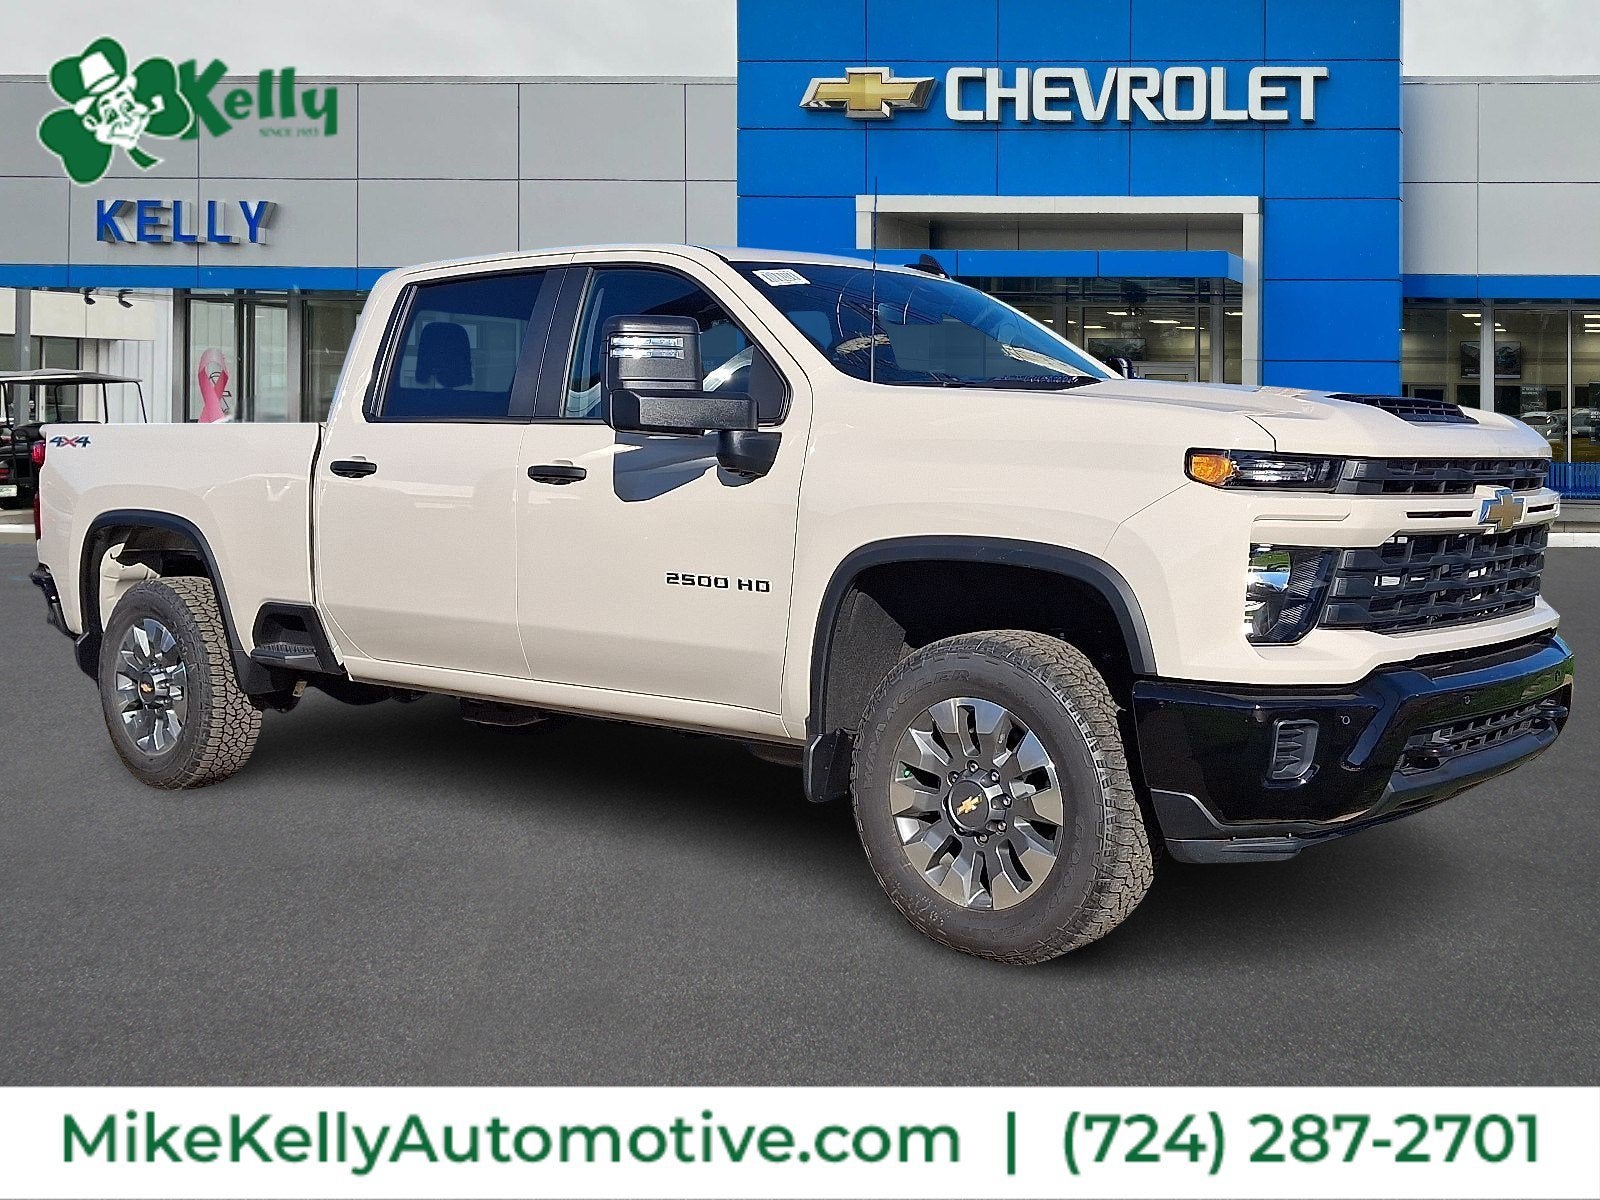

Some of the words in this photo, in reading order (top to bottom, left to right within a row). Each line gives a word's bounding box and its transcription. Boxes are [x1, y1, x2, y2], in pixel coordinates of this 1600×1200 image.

[945, 66, 1330, 122] CHEVROLET
[96, 199, 274, 244] KELLY
[666, 572, 729, 589] 2500
[737, 578, 770, 593] HD
